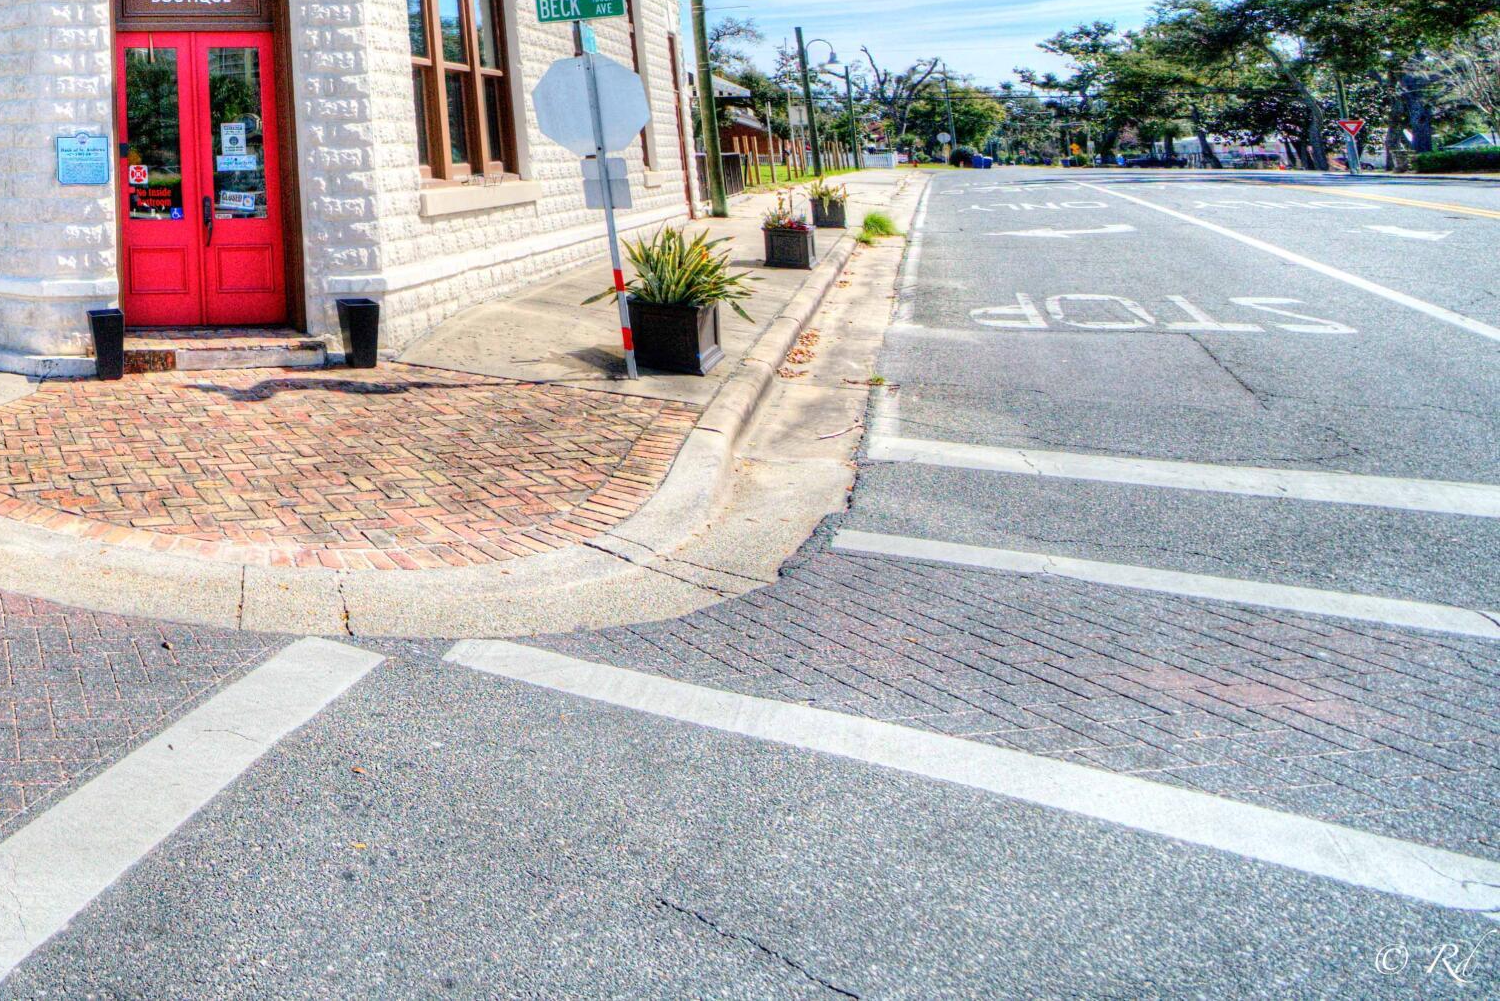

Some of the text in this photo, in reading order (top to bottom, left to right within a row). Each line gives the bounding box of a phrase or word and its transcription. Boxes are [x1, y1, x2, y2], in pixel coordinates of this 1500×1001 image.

[595, 3, 613, 15] AVE
[136, 188, 172, 197] No Inside
[958, 201, 1109, 212] ONLY
[969, 292, 1359, 334] STOP
